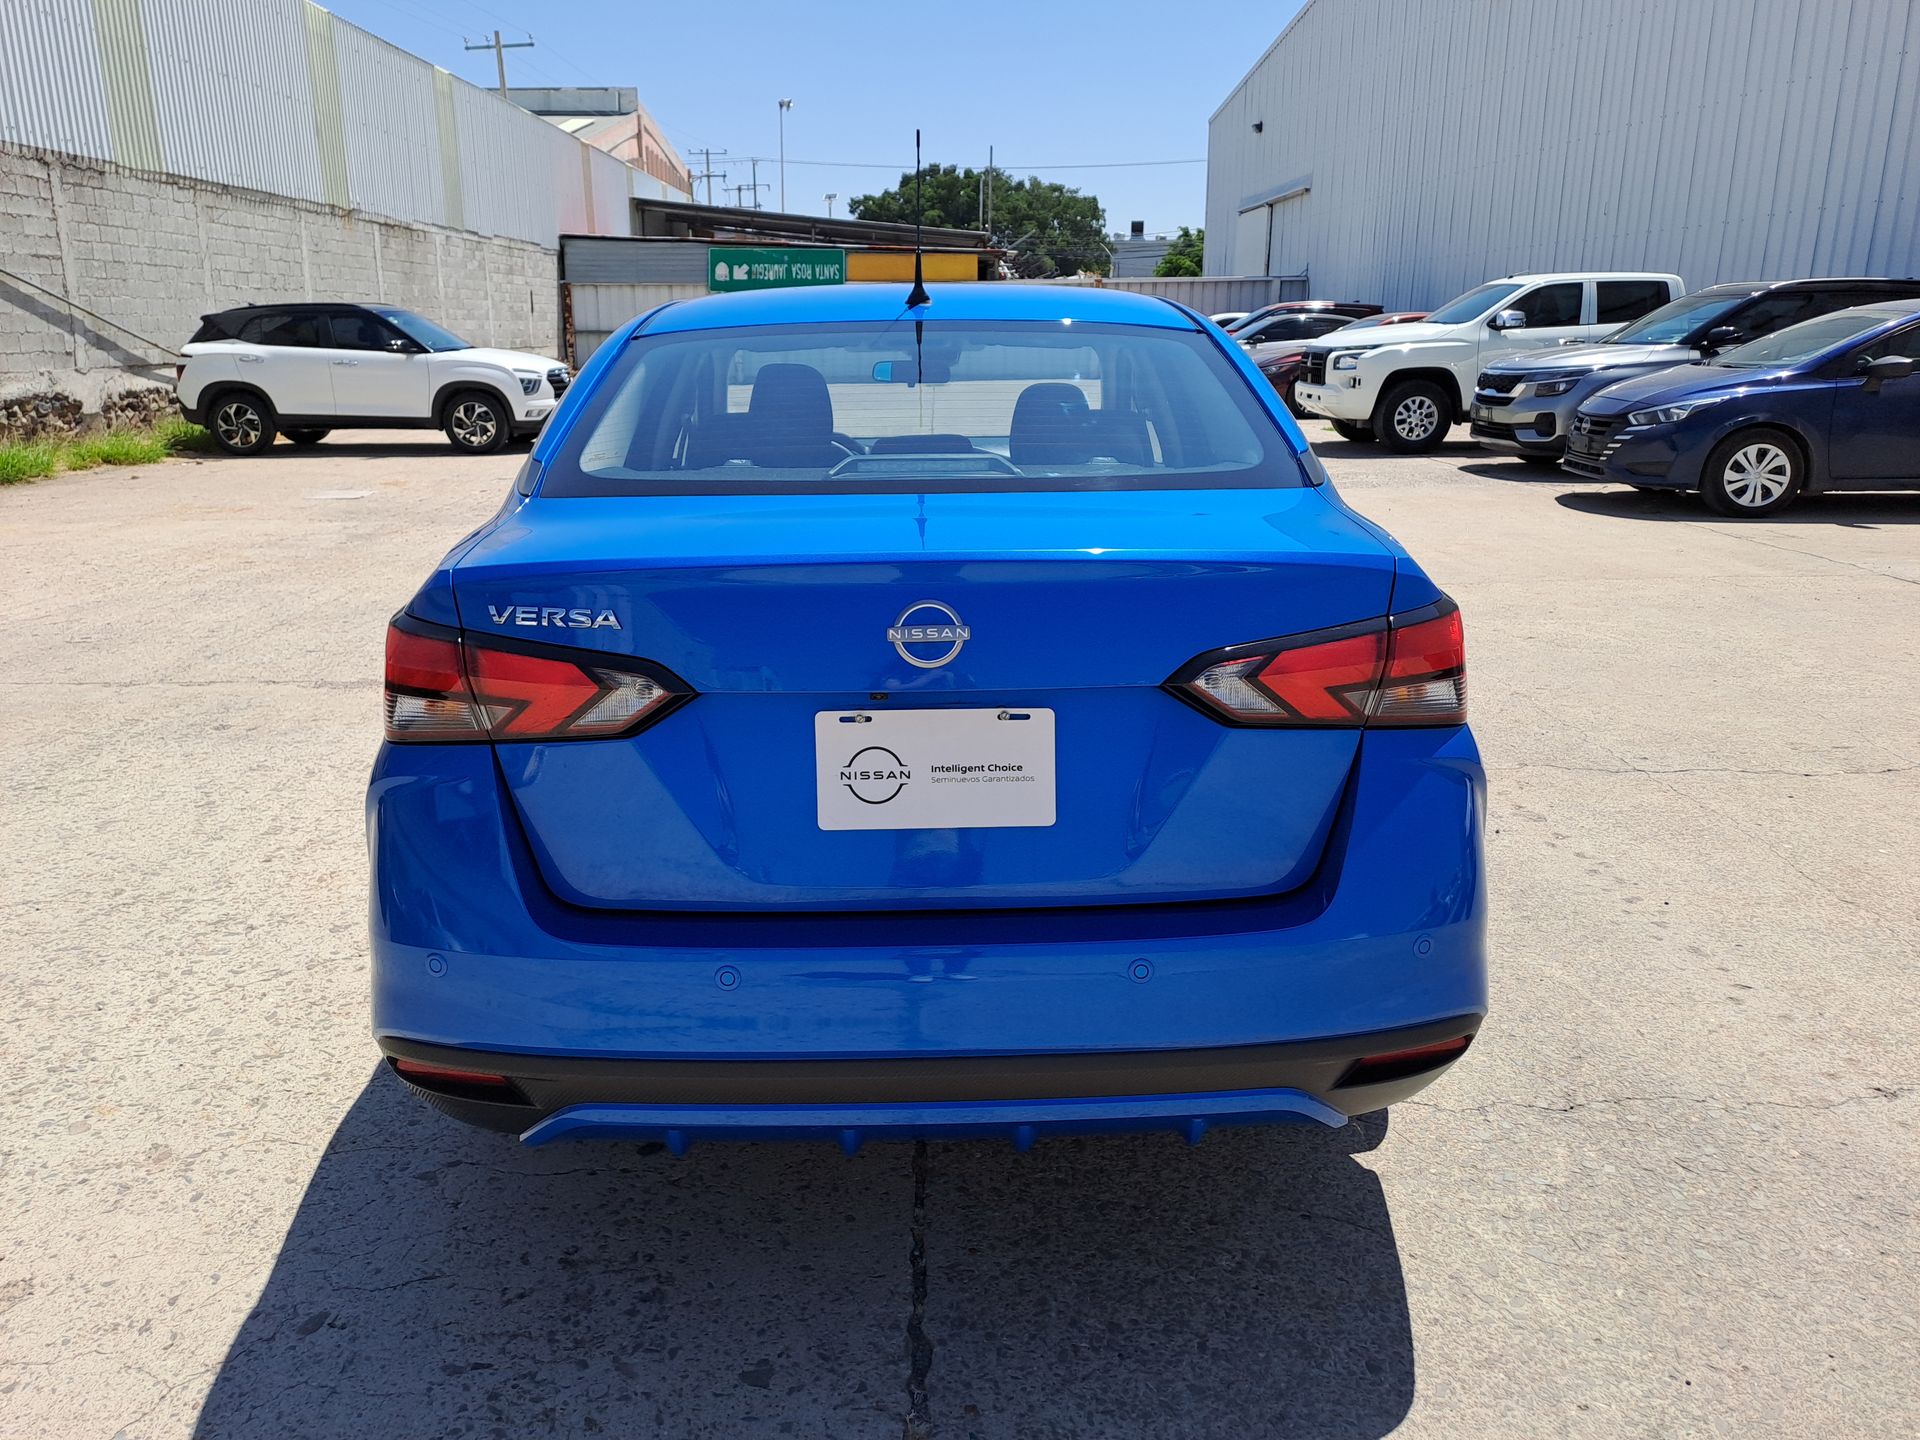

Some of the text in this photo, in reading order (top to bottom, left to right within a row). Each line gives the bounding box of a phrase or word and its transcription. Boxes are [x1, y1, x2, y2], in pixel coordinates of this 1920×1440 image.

[751, 263, 840, 280] SANTA ROSA JAUREGUI
[488, 605, 623, 630] VERSA
[889, 627, 968, 639] NISSAN
[840, 769, 911, 781] NISSAN
[931, 763, 1023, 775] Intelligent Choice
[931, 775, 1035, 784] Seminuevos Garantizados
